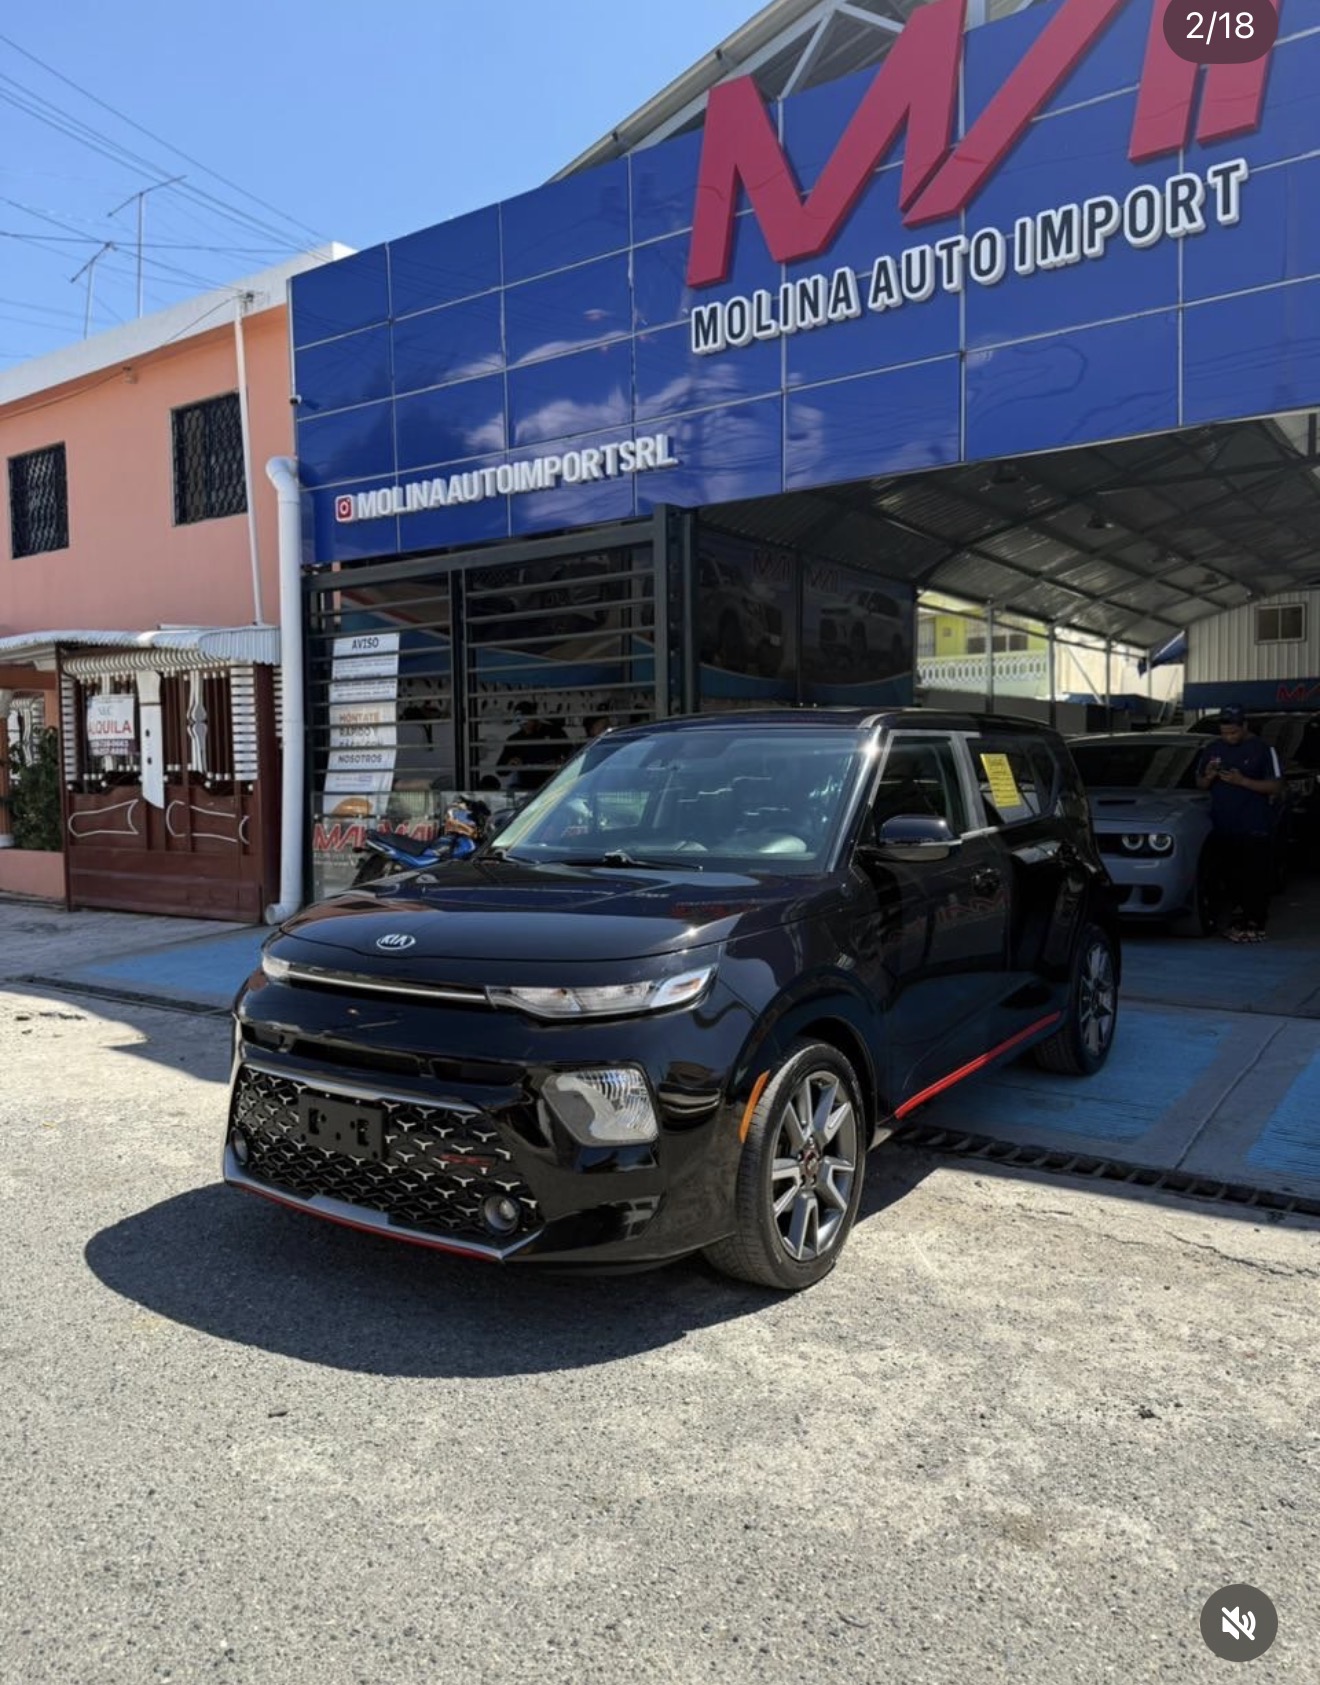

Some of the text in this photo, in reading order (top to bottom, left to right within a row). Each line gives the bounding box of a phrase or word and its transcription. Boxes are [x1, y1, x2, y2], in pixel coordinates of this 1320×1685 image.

[691, 158, 1250, 354] MOLINA AUTO IMPORT
[357, 434, 679, 519] MOLINAAUTOIMPORTSRL
[351, 637, 379, 649] AVISO
[338, 754, 382, 763] NOSOTROS
[379, 934, 411, 947] KIA
